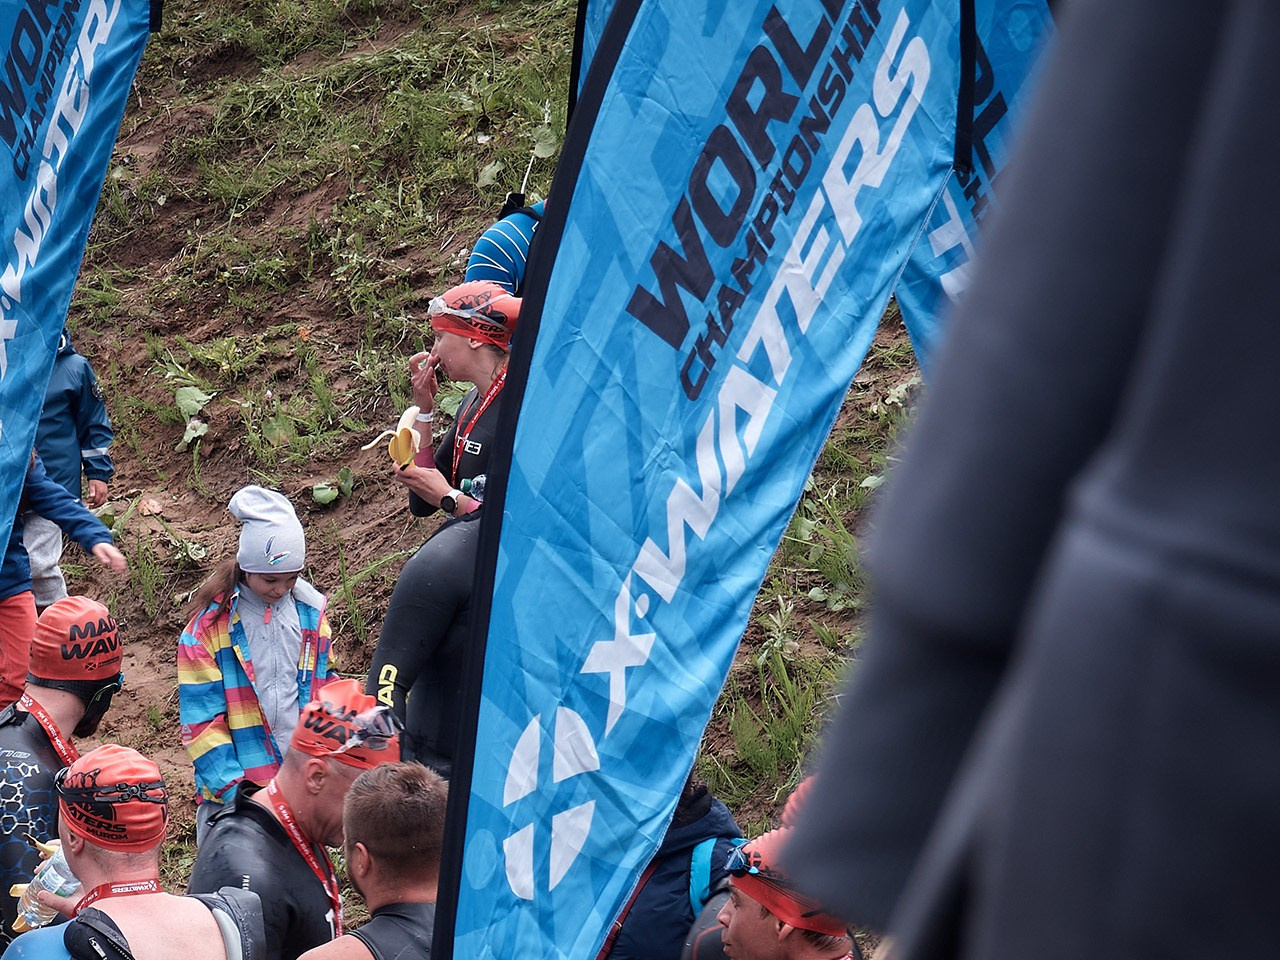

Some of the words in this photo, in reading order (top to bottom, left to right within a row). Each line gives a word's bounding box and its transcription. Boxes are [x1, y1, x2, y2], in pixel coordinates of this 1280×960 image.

[626, 0, 847, 352] WORL
[61, 633, 121, 660] WAV
[377, 664, 398, 708] AD
[35, 709, 46, 720] KM
[44, 722, 58, 738] 2025
[52, 735, 69, 756] MUROM
[68, 805, 127, 833] ATERS
[279, 808, 290, 820] KM
[86, 826, 129, 840] MUROM
[110, 884, 149, 893] XWATERS
